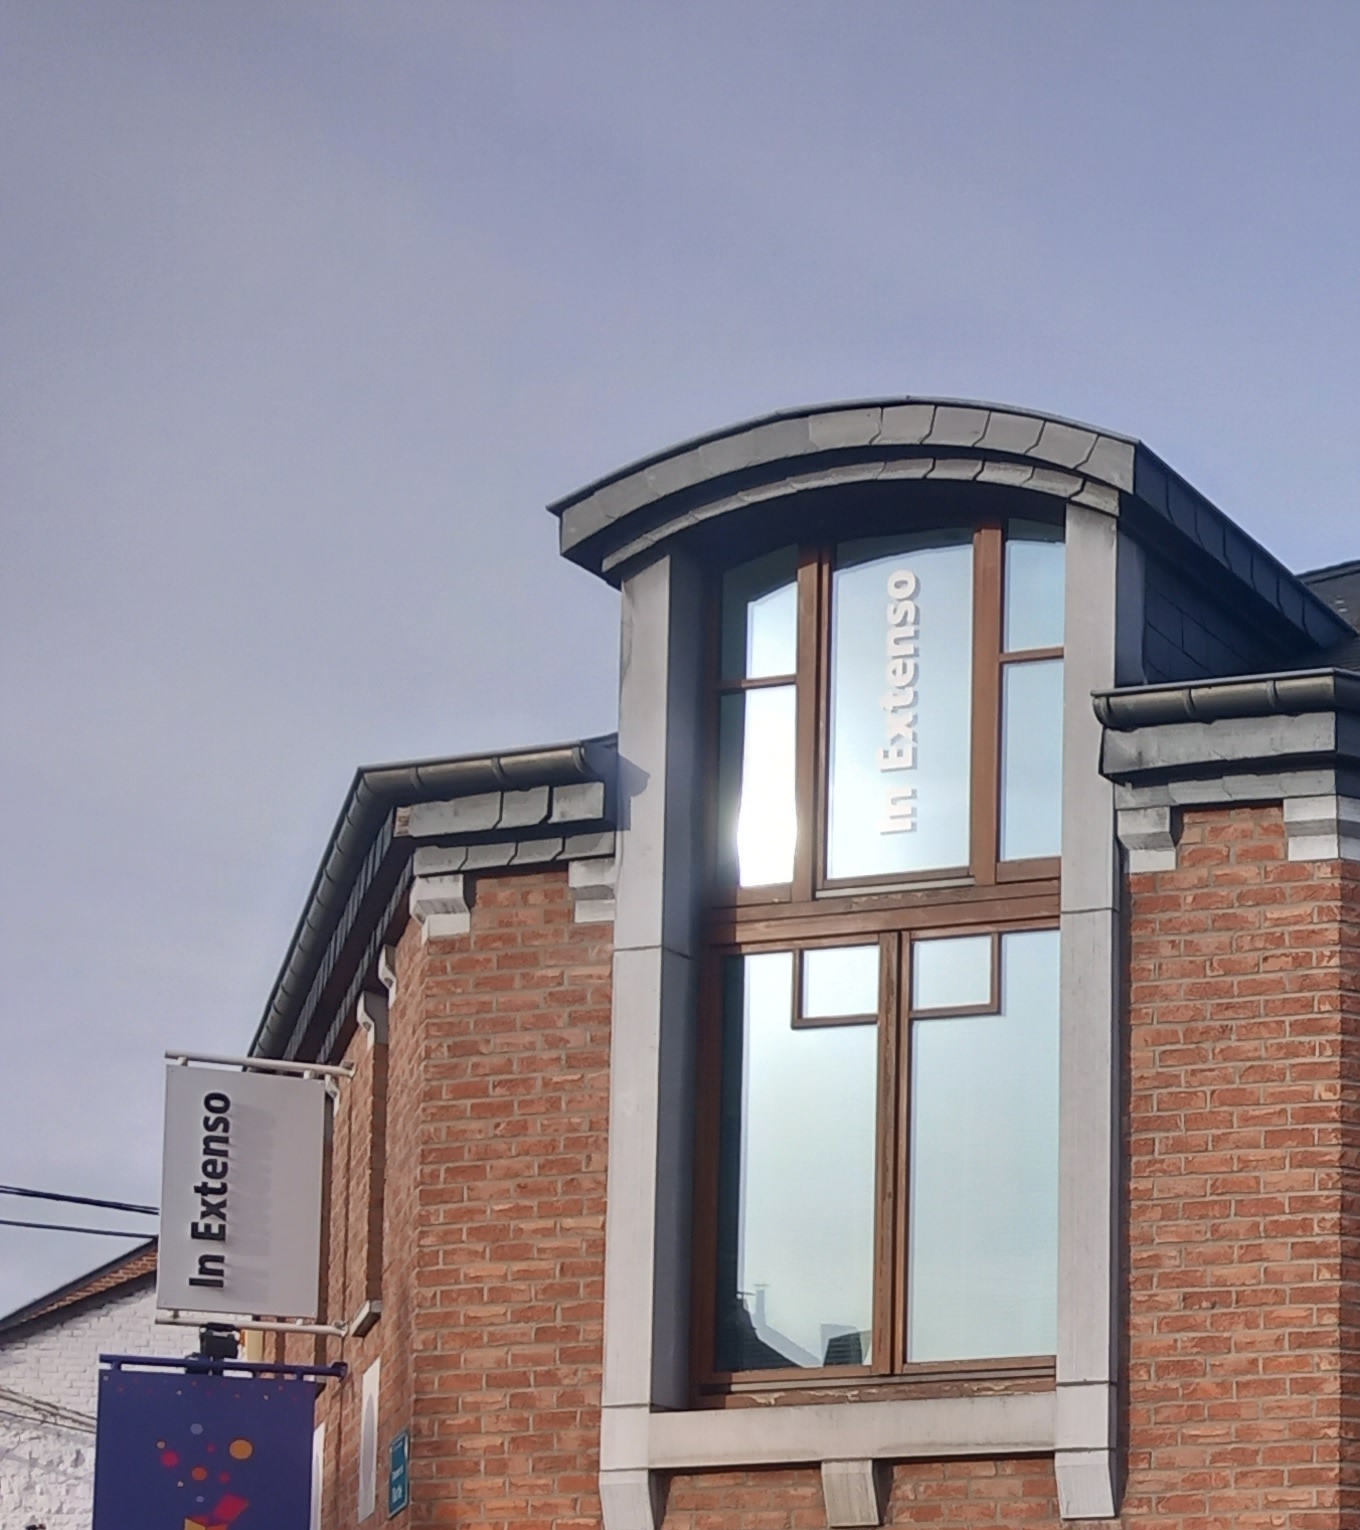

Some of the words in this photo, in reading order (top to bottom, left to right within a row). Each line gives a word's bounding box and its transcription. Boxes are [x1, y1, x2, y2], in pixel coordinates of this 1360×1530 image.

[878, 568, 920, 772] Extenso
[880, 786, 918, 836] In
[190, 1092, 231, 1242] Extenso
[188, 1254, 225, 1288] In
